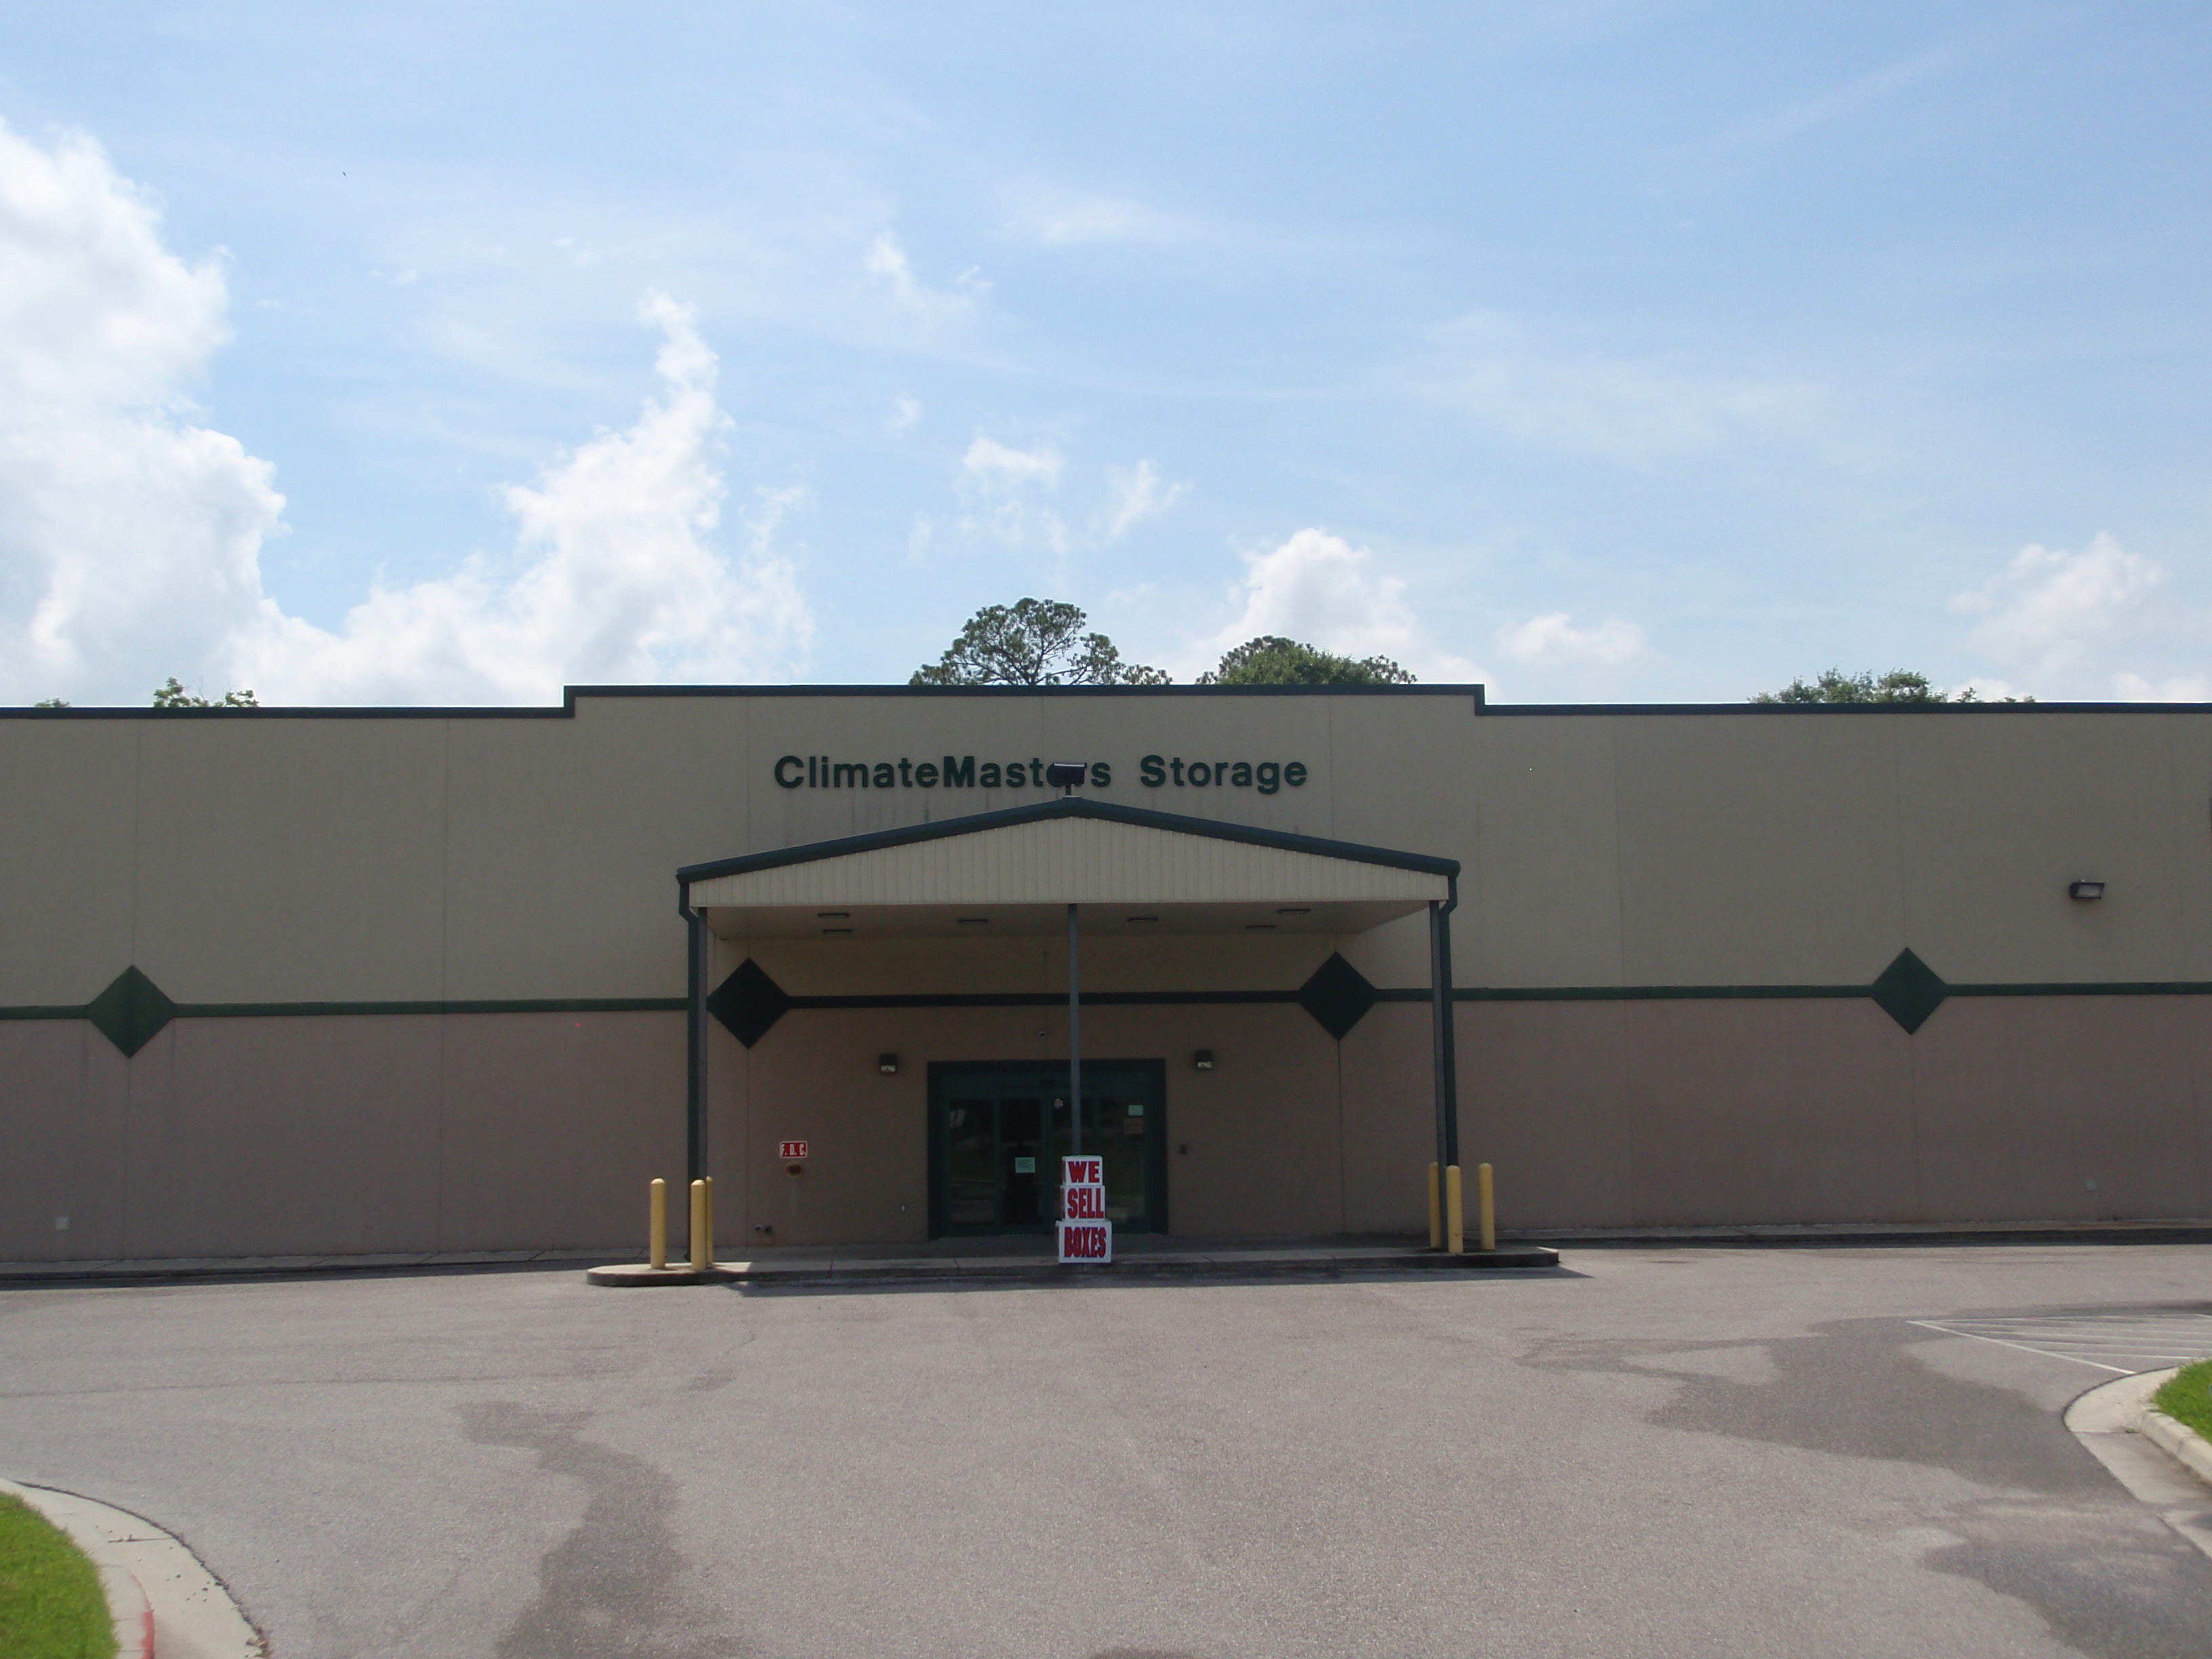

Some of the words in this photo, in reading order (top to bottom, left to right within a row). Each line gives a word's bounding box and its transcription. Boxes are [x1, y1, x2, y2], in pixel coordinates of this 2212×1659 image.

[774, 755, 1111, 789] ClimateMasts
[1140, 754, 1308, 794] Storage
[1067, 1161, 1100, 1183] WE
[1067, 1188, 1104, 1218] SELL
[1064, 1227, 1107, 1258] BOXES
